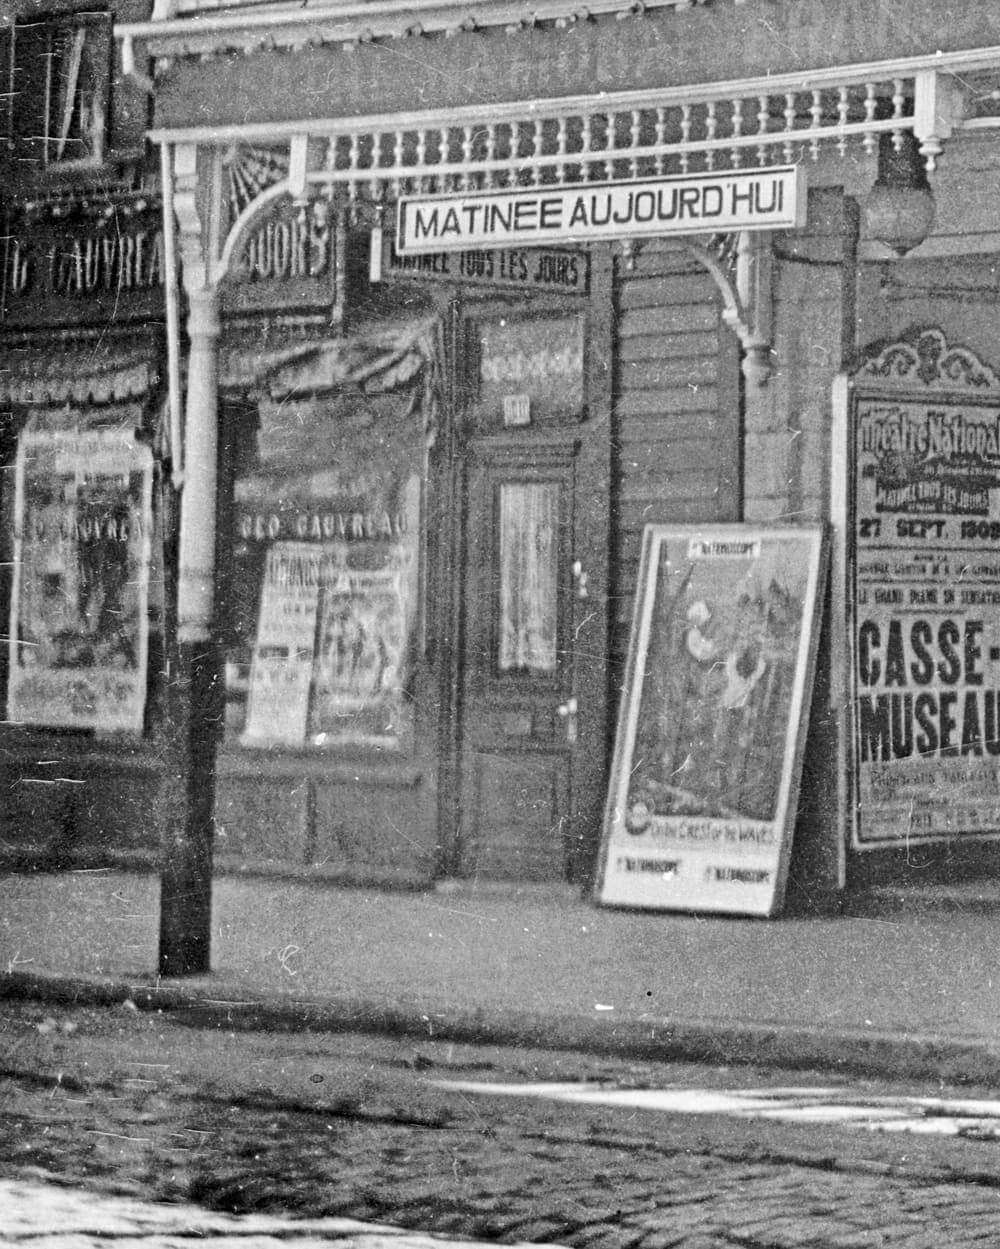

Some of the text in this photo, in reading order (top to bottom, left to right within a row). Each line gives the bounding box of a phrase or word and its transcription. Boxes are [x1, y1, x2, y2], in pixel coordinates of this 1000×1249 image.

[414, 179, 784, 239] MATINEE AUJOURD'HUI
[501, 252, 528, 282] LES
[534, 256, 578, 287] JOURS
[859, 518, 882, 538] 27
[859, 619, 1000, 687] CASSE-
